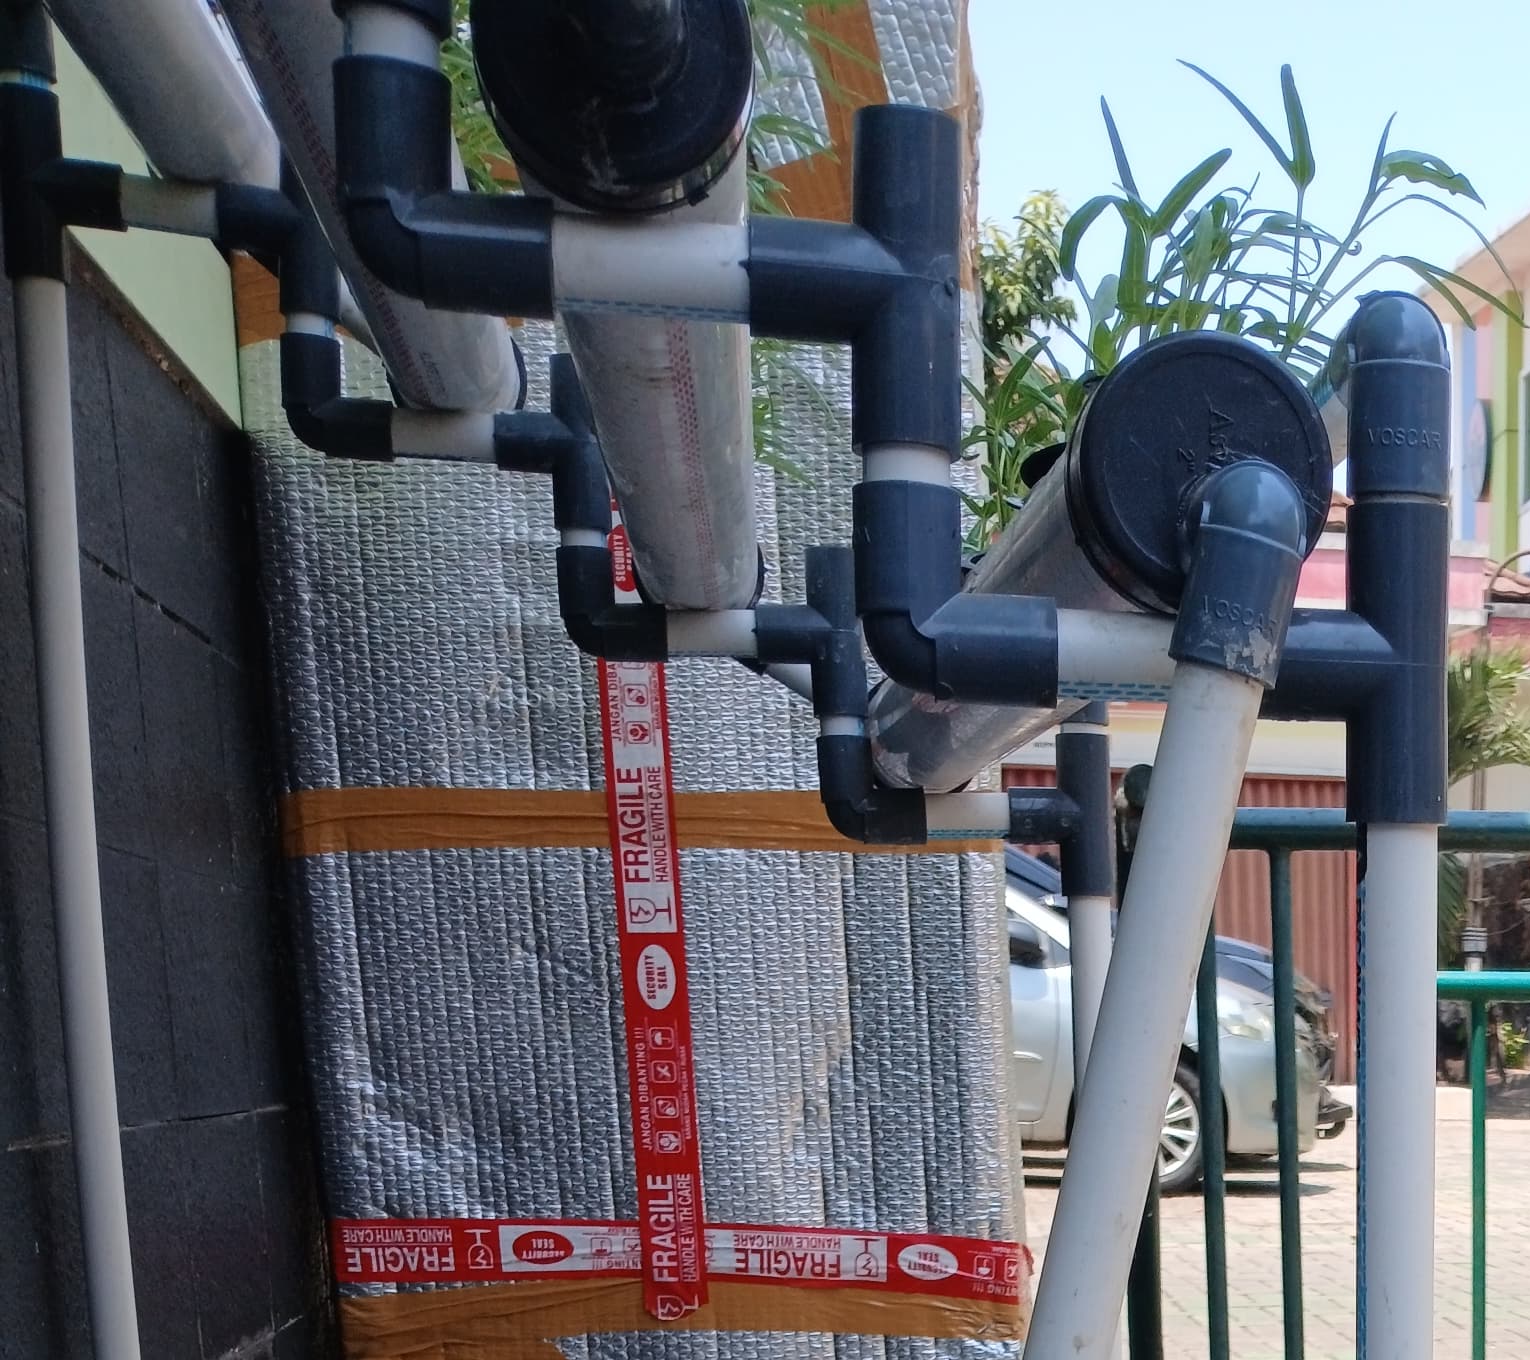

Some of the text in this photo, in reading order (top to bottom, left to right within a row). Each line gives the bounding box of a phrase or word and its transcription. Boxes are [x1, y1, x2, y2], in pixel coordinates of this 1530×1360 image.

[1367, 427, 1442, 449] VOSCAR
[612, 533, 627, 582] SECURITY
[610, 695, 622, 741] JANGAN
[616, 767, 650, 884] FRAGILE
[647, 767, 669, 882] HANDLE WITH CARE
[643, 955, 657, 1000] SECURITY
[656, 965, 667, 989] SEAL
[635, 1043, 649, 1103] DIBANTING
[639, 1105, 652, 1150] JANGAN
[343, 1229, 451, 1244] HANDLE WITH CARE
[531, 1238, 555, 1249] SEAL
[646, 1174, 679, 1283] FRAGILE
[676, 1173, 697, 1283] HANDLE WITH CARE
[733, 1234, 841, 1249] HANDLE WITH CARE
[345, 1247, 455, 1273] FRAGILE
[735, 1247, 841, 1280] FRAGILE
